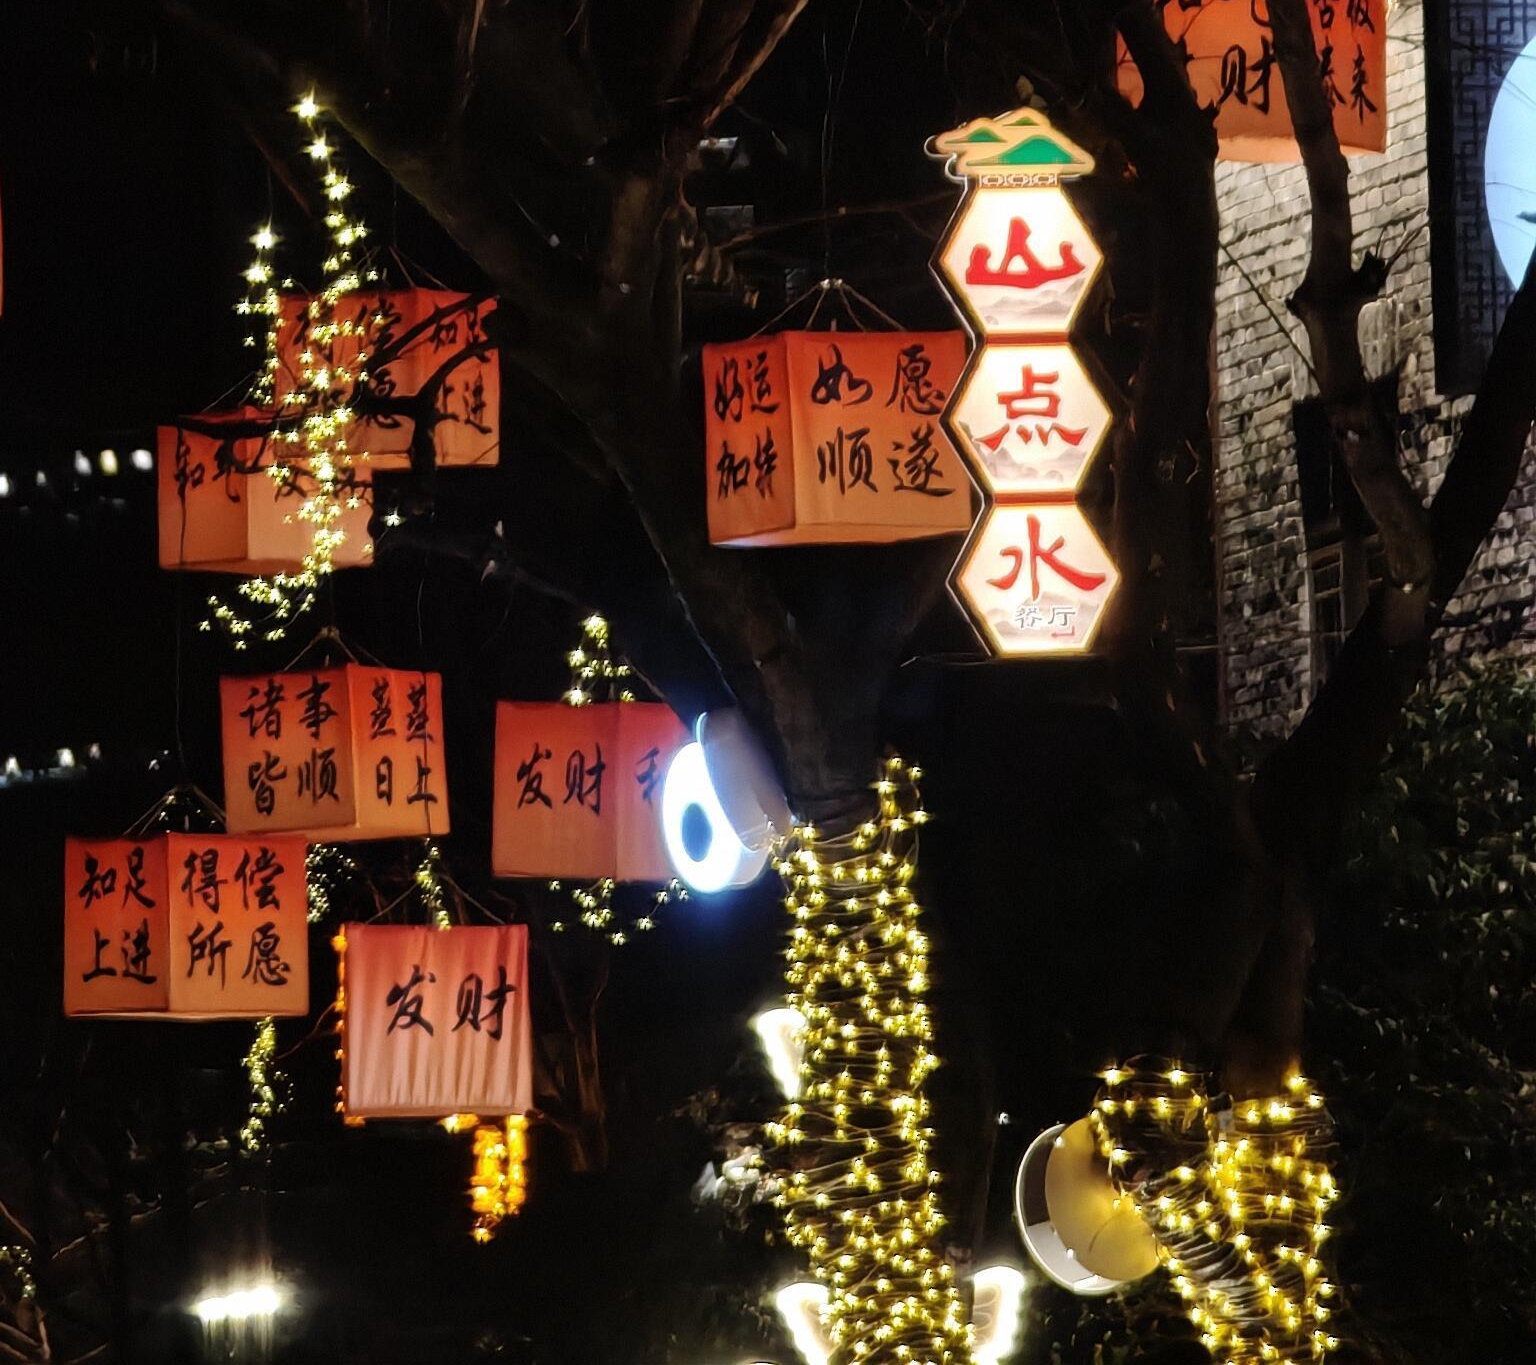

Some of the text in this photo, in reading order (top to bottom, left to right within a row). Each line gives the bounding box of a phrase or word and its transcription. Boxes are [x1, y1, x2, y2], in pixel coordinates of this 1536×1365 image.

[714, 348, 781, 423] 好运
[810, 342, 947, 417] 如愿
[966, 215, 1106, 601] 山点水
[815, 420, 957, 498] 顺遂
[1014, 607, 1077, 629] 餐厅
[239, 676, 339, 740] 诸事
[247, 747, 340, 817] 皆顺
[374, 755, 439, 807] 日上
[516, 741, 607, 817] 发财
[77, 845, 156, 910] 知足
[180, 845, 285, 915] 得偿
[82, 917, 158, 986] 上进
[185, 920, 291, 992] 所愿
[385, 964, 518, 1042] 发财
